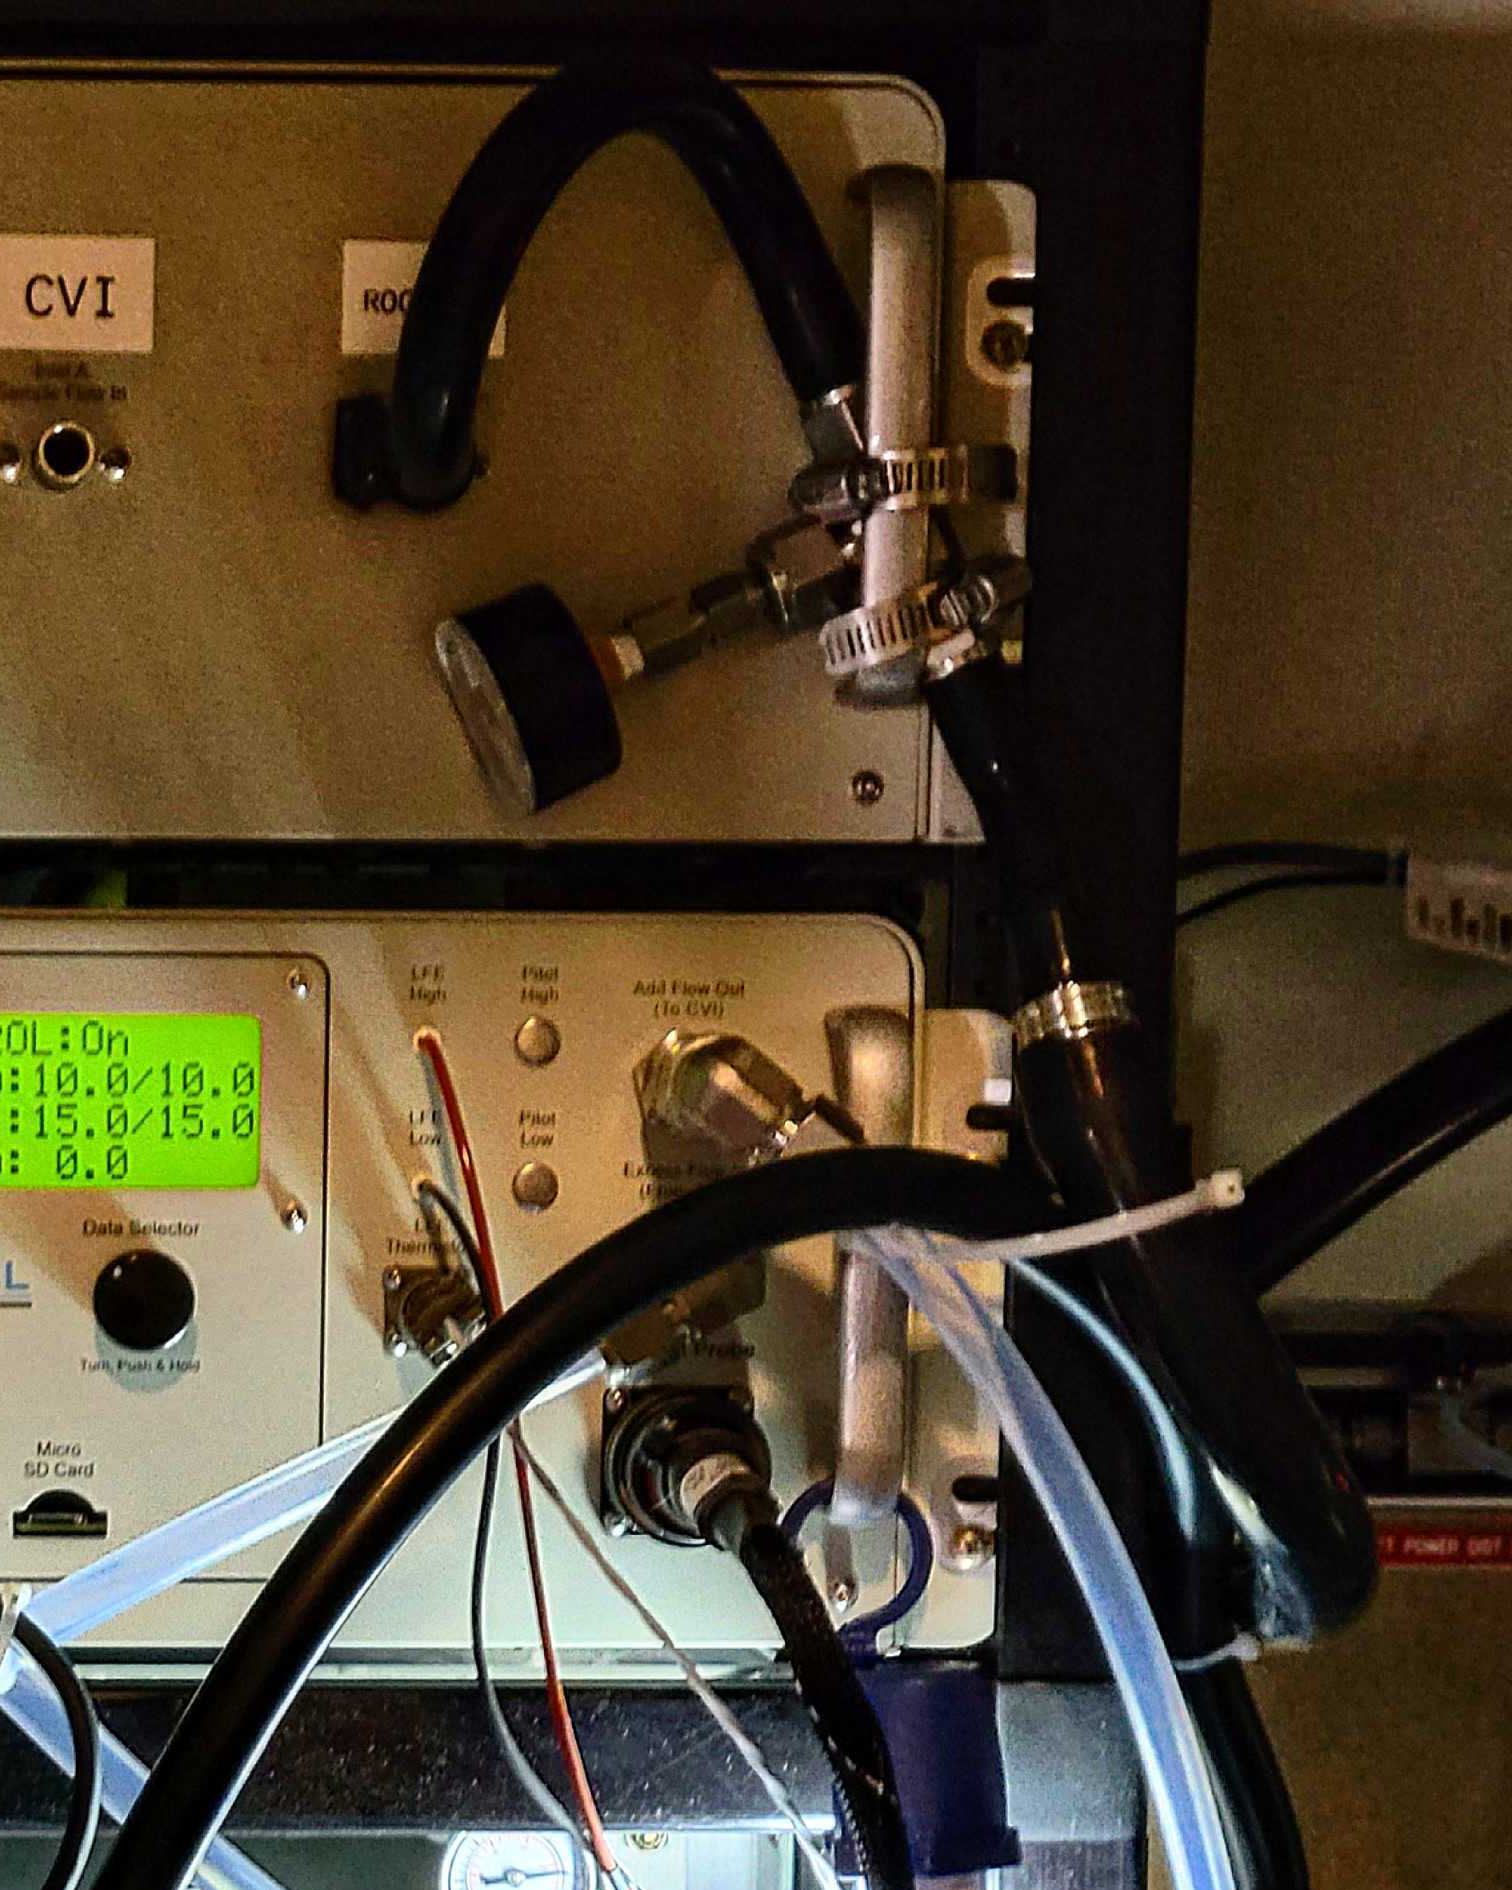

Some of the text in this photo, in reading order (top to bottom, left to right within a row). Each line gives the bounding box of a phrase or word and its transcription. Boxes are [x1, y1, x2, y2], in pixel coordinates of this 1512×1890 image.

[24, 274, 116, 320] CVI
[364, 287, 414, 316] ROO
[409, 984, 447, 1006] High
[520, 985, 560, 1006] High
[671, 979, 711, 997] Flow
[518, 1108, 557, 1127] Pilot
[519, 1129, 555, 1149] Low
[55, 1144, 130, 1181] 0.0
[82, 1218, 200, 1236] Data Selector
[118, 1358, 153, 1374] Push
[36, 1440, 82, 1458] Micro
[23, 1460, 95, 1479] SD Card
